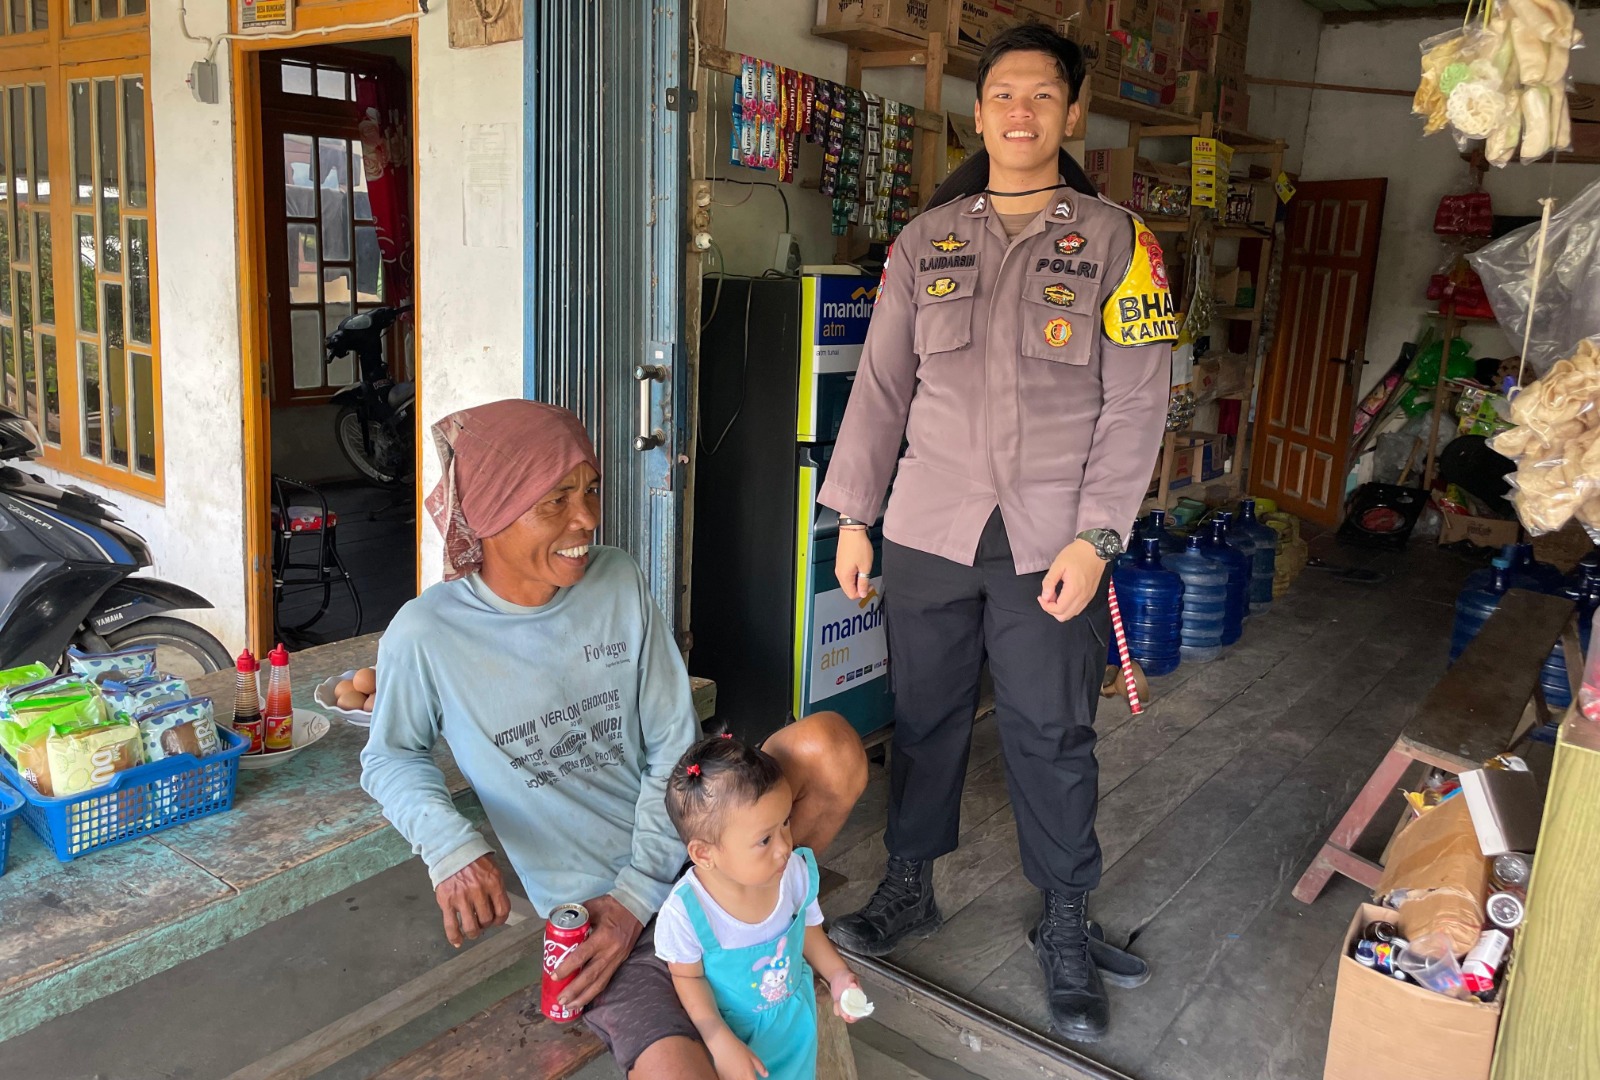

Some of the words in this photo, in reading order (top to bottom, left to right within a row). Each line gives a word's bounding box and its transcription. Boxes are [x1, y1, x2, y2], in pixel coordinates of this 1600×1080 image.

[745, 66, 754, 100] Downy
[764, 70, 772, 102] Downy
[805, 92, 813, 124] Downy
[1035, 258, 1098, 280] POLRI
[823, 298, 874, 318] mandir
[823, 321, 845, 337] atm
[96, 612, 124, 627] YAMAHA
[820, 646, 850, 671] atm
[540, 702, 581, 728] VERLON
[581, 689, 620, 712] GHOXONE
